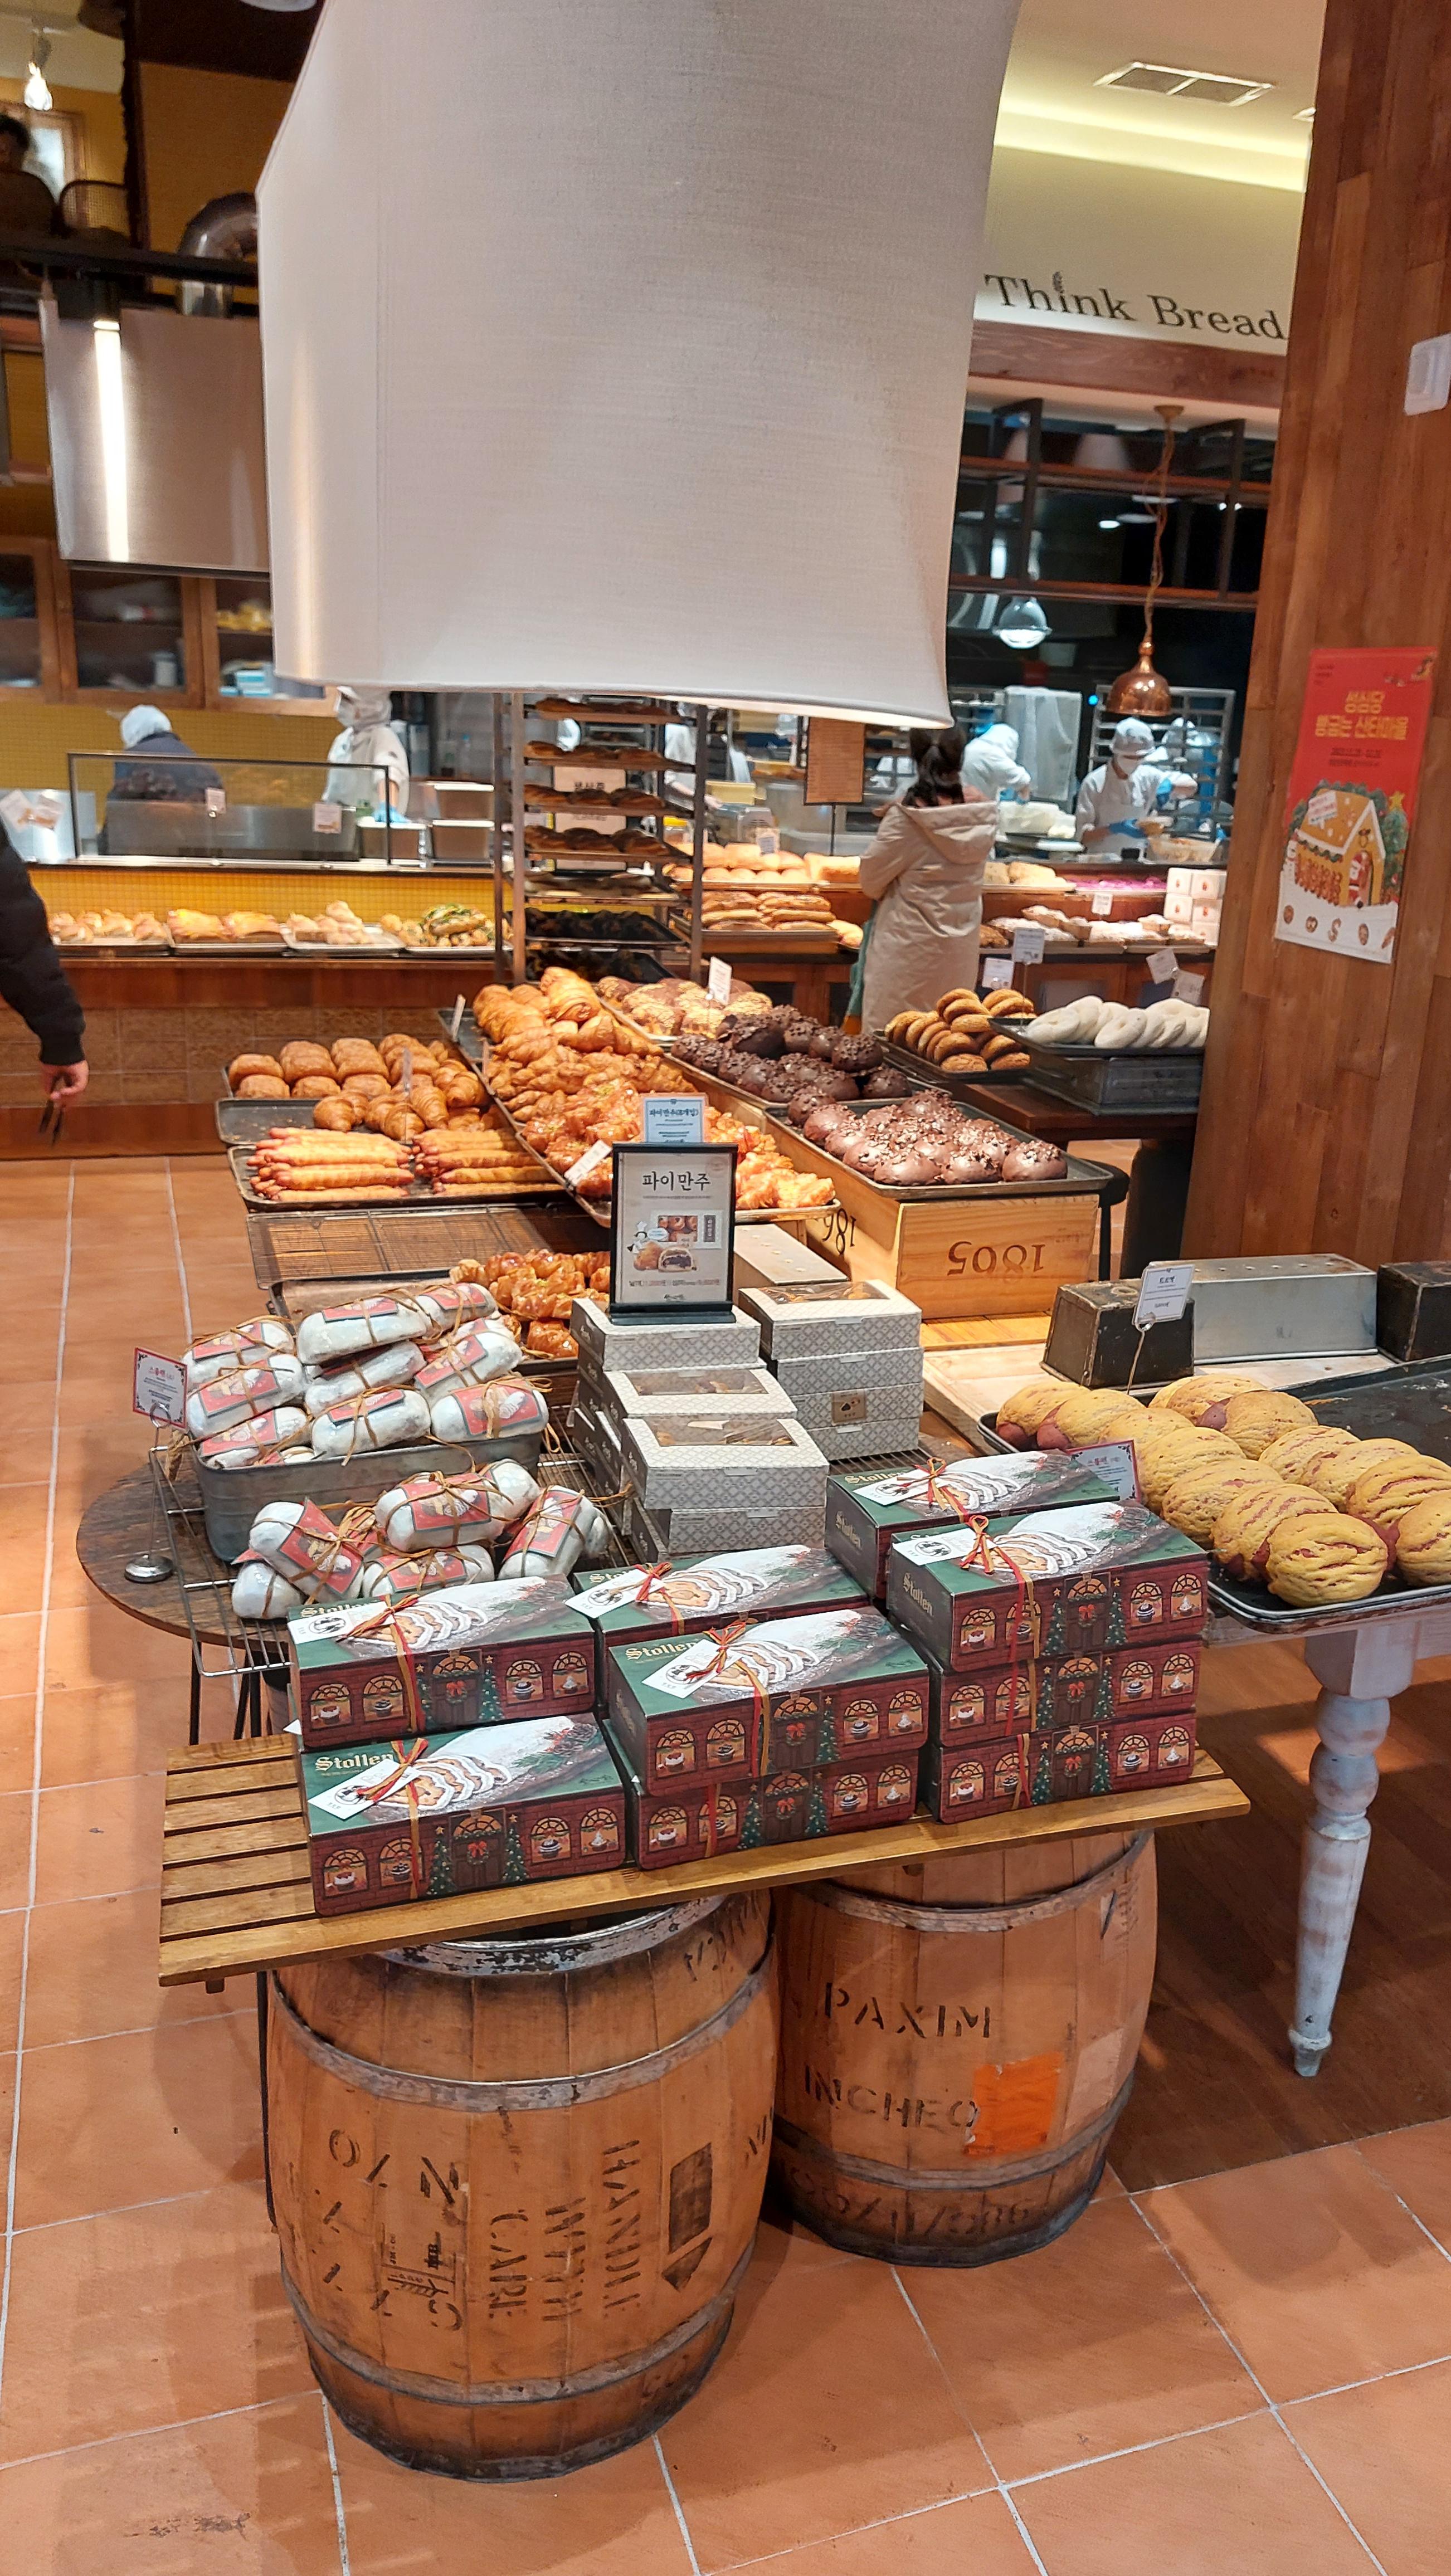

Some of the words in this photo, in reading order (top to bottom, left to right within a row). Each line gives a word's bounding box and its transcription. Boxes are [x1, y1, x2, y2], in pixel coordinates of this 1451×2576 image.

[984, 272, 1136, 322] Think
[1148, 295, 1287, 340] Bread
[642, 1171, 712, 1192] 파이만주
[820, 1208, 856, 1256] 186
[947, 1241, 1045, 1282] 1805
[845, 1472, 905, 1485] Stolle
[300, 1604, 368, 1617] Stoll
[903, 1572, 933, 1617] Stollen
[825, 1982, 991, 2039] PAXIM
